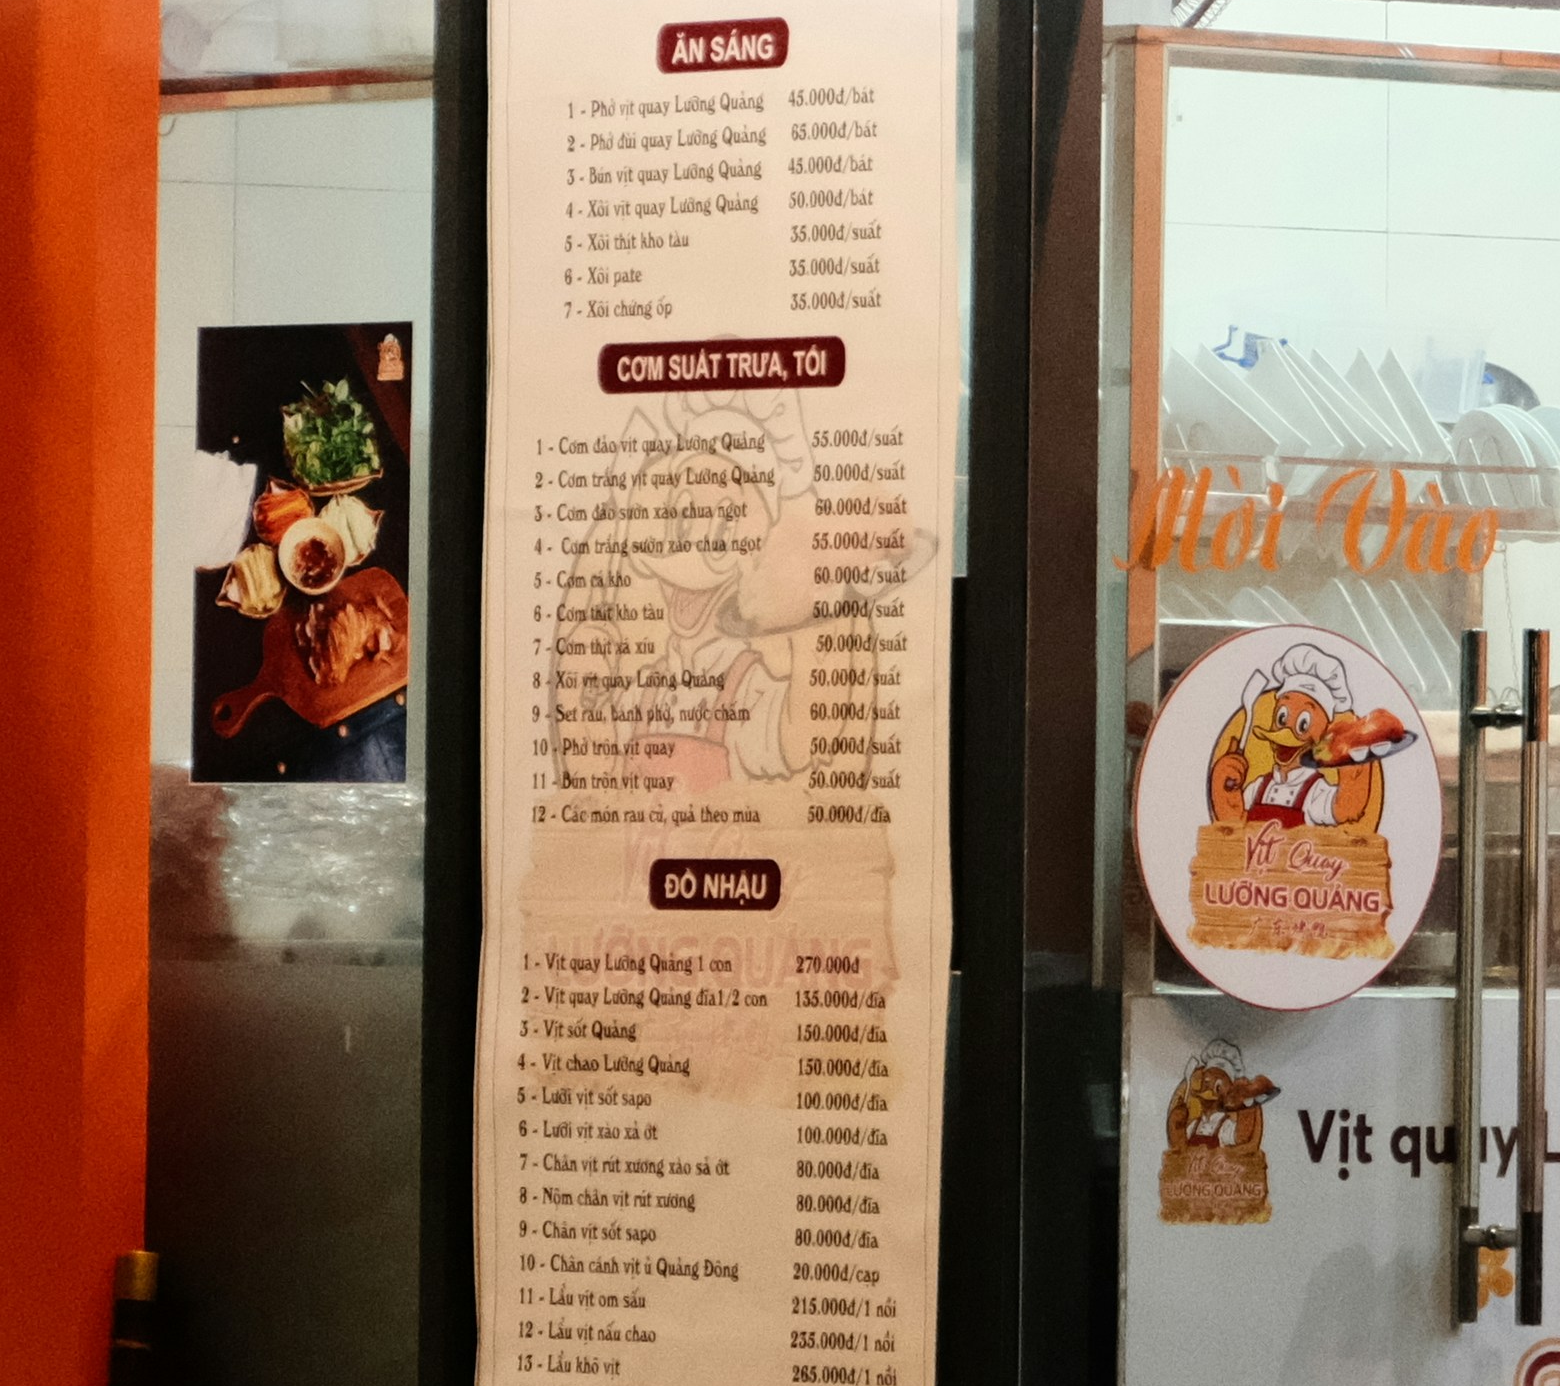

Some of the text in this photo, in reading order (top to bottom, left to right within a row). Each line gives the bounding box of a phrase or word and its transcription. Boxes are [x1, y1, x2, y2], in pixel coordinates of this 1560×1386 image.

[671, 29, 775, 65] ĂN SÁNG
[638, 99, 671, 117] quay
[674, 95, 716, 115] Lưỡng
[719, 91, 765, 113] Quảng
[616, 345, 827, 383] CƠM SUẤT TRƯA, TỐI
[1114, 463, 1500, 573] Mời Vào
[1245, 819, 1349, 882] Vịt Quay
[663, 866, 768, 906] ĐỒ NHẬU
[1205, 881, 1288, 907] LƯỠNG
[1297, 1108, 1373, 1181] Vịt
[1390, 1123, 1519, 1178] quy
